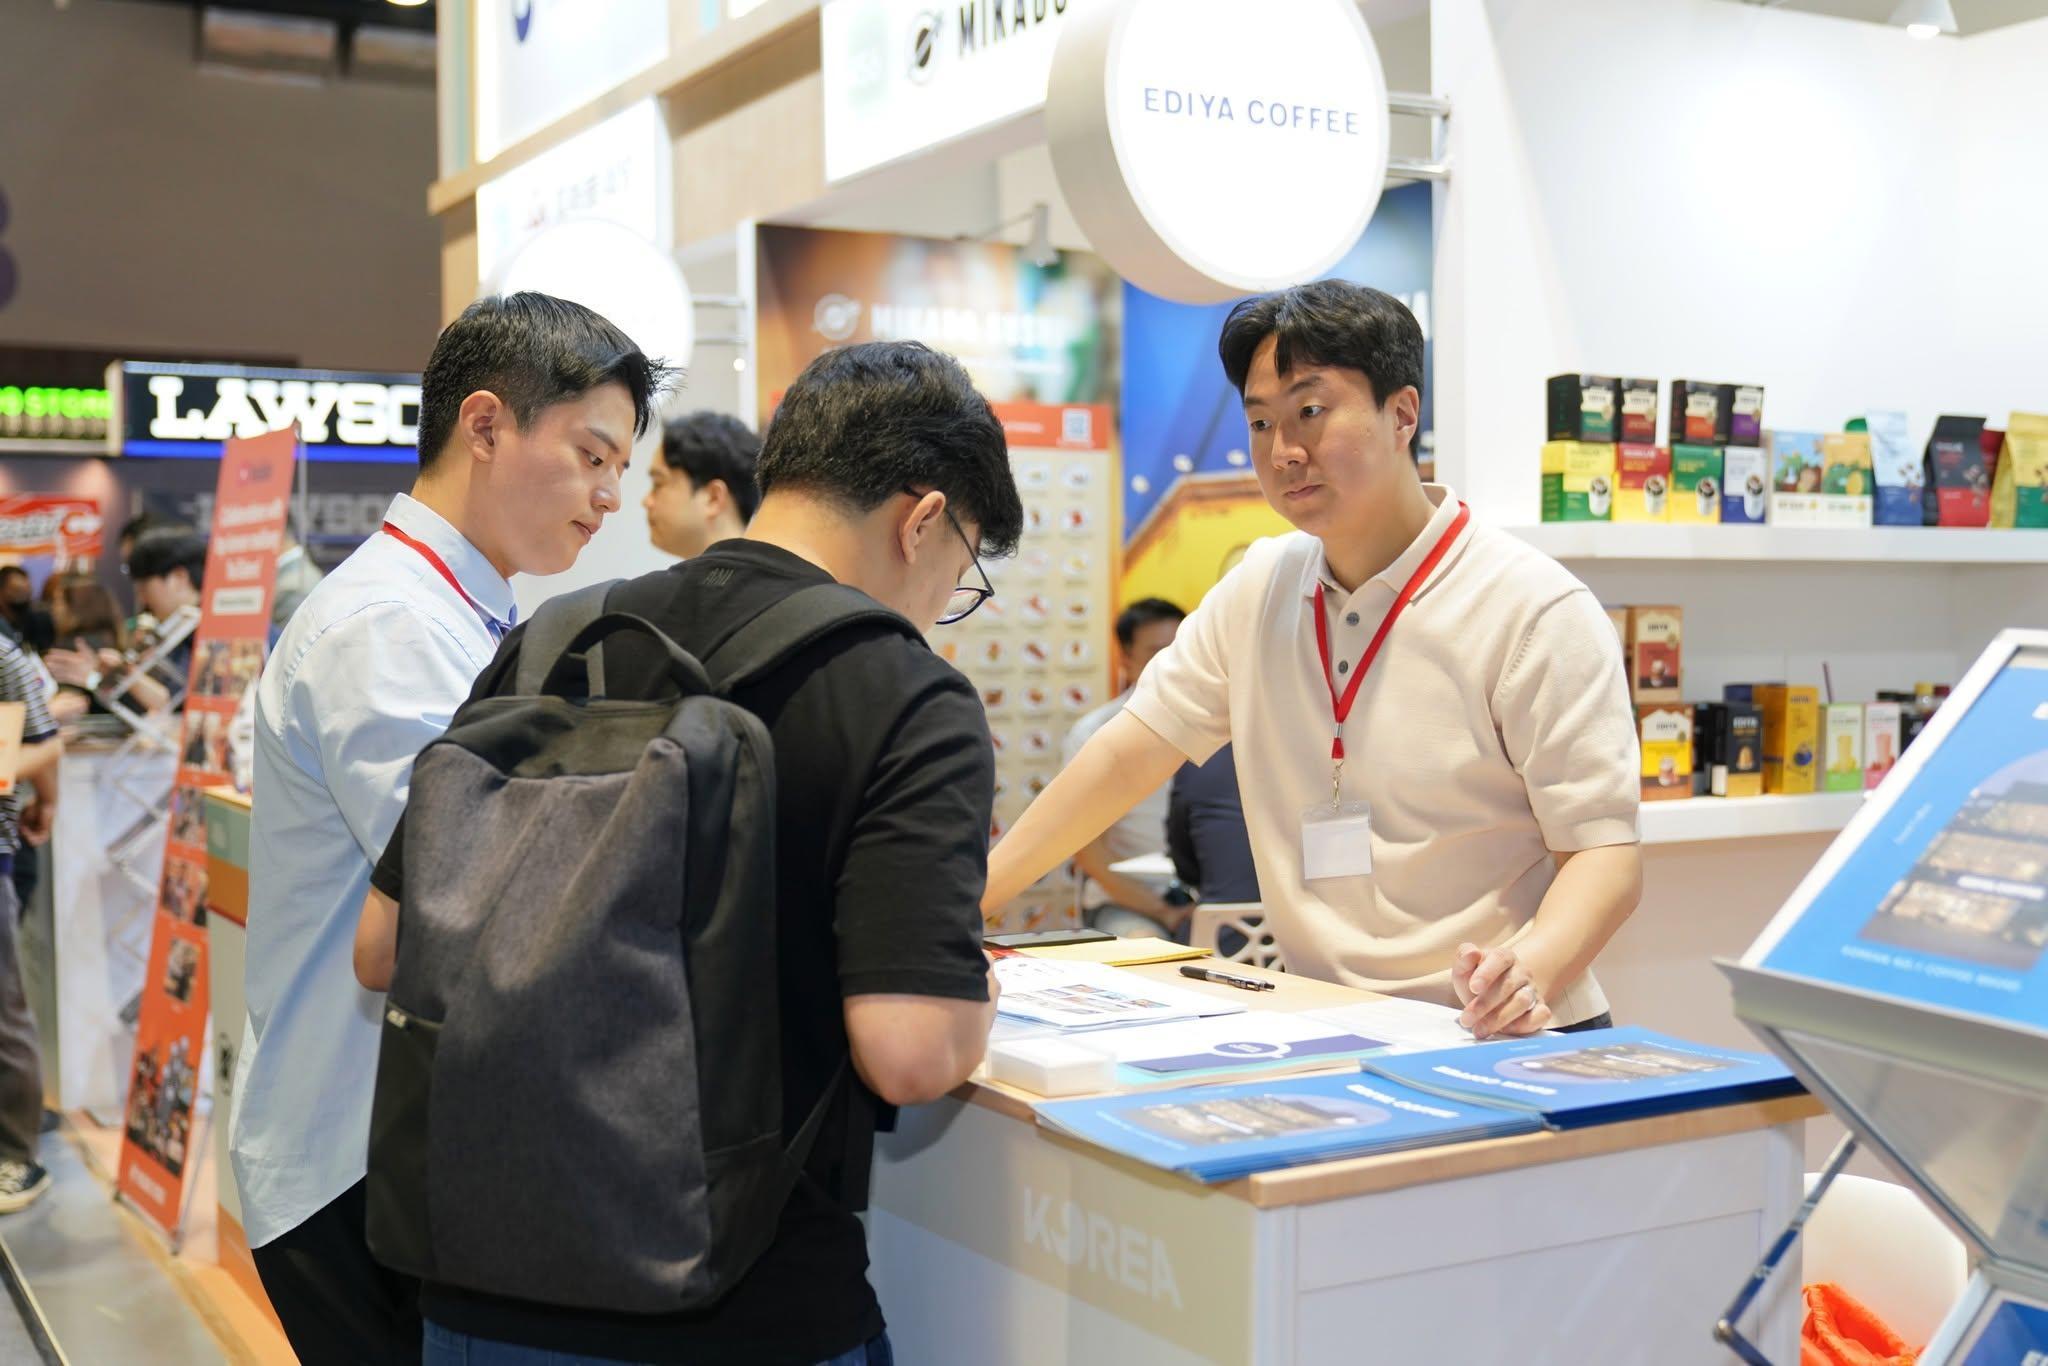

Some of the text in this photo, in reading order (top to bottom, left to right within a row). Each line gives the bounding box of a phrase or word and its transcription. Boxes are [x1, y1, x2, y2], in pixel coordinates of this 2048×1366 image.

[1144, 87, 1359, 135] EDIYA COFFEE
[1023, 1186, 1183, 1311] KOREA
